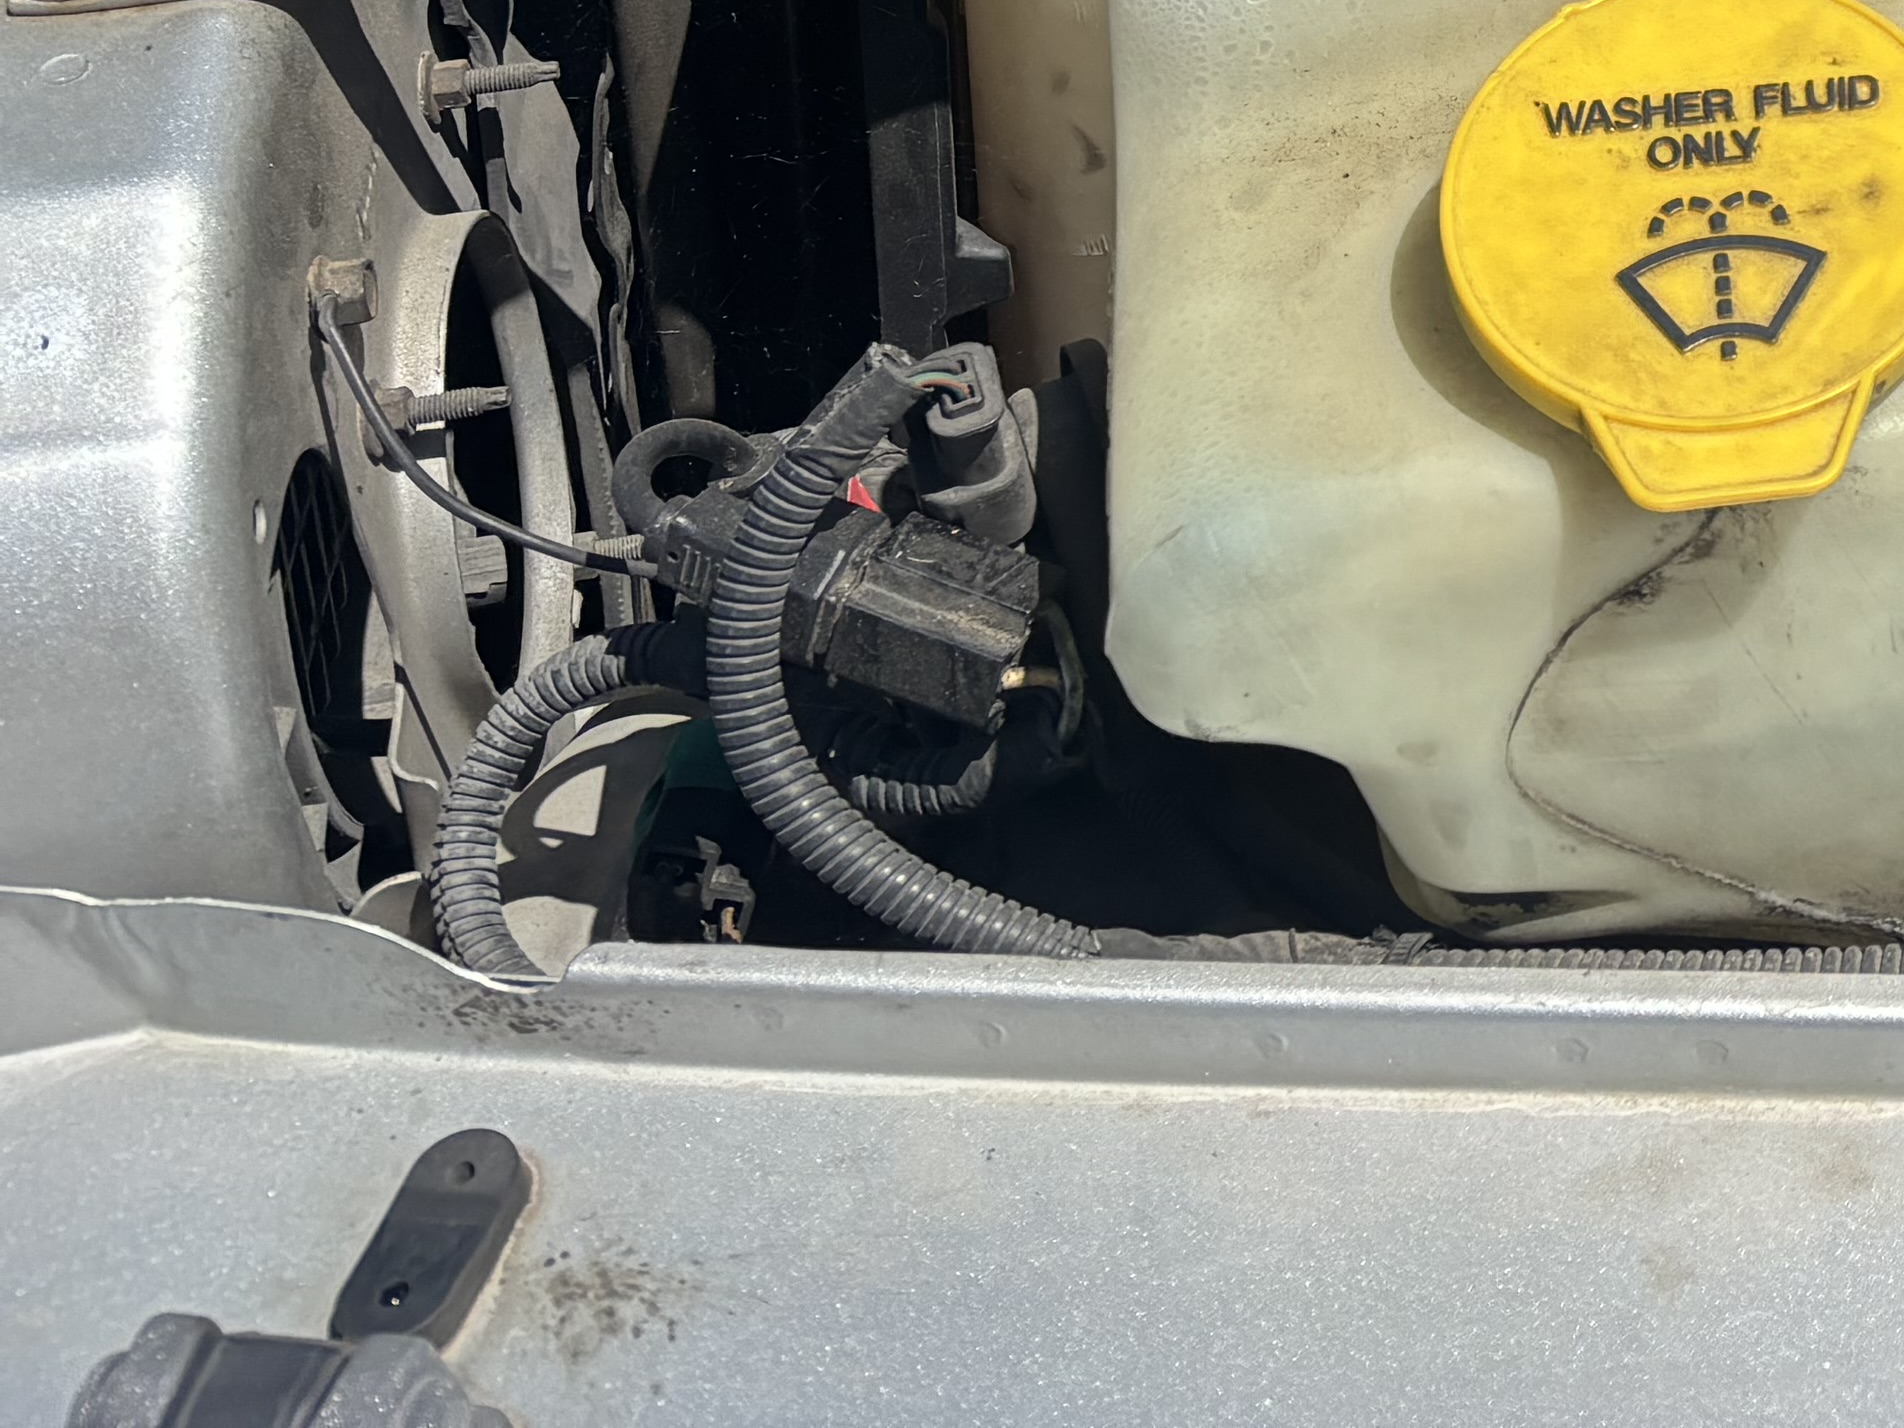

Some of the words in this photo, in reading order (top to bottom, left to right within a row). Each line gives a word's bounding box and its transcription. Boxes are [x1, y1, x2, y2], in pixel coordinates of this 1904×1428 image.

[1541, 88, 1735, 139] WASHER
[1752, 74, 1881, 120] FLUID
[1646, 126, 1762, 172] ONLY
